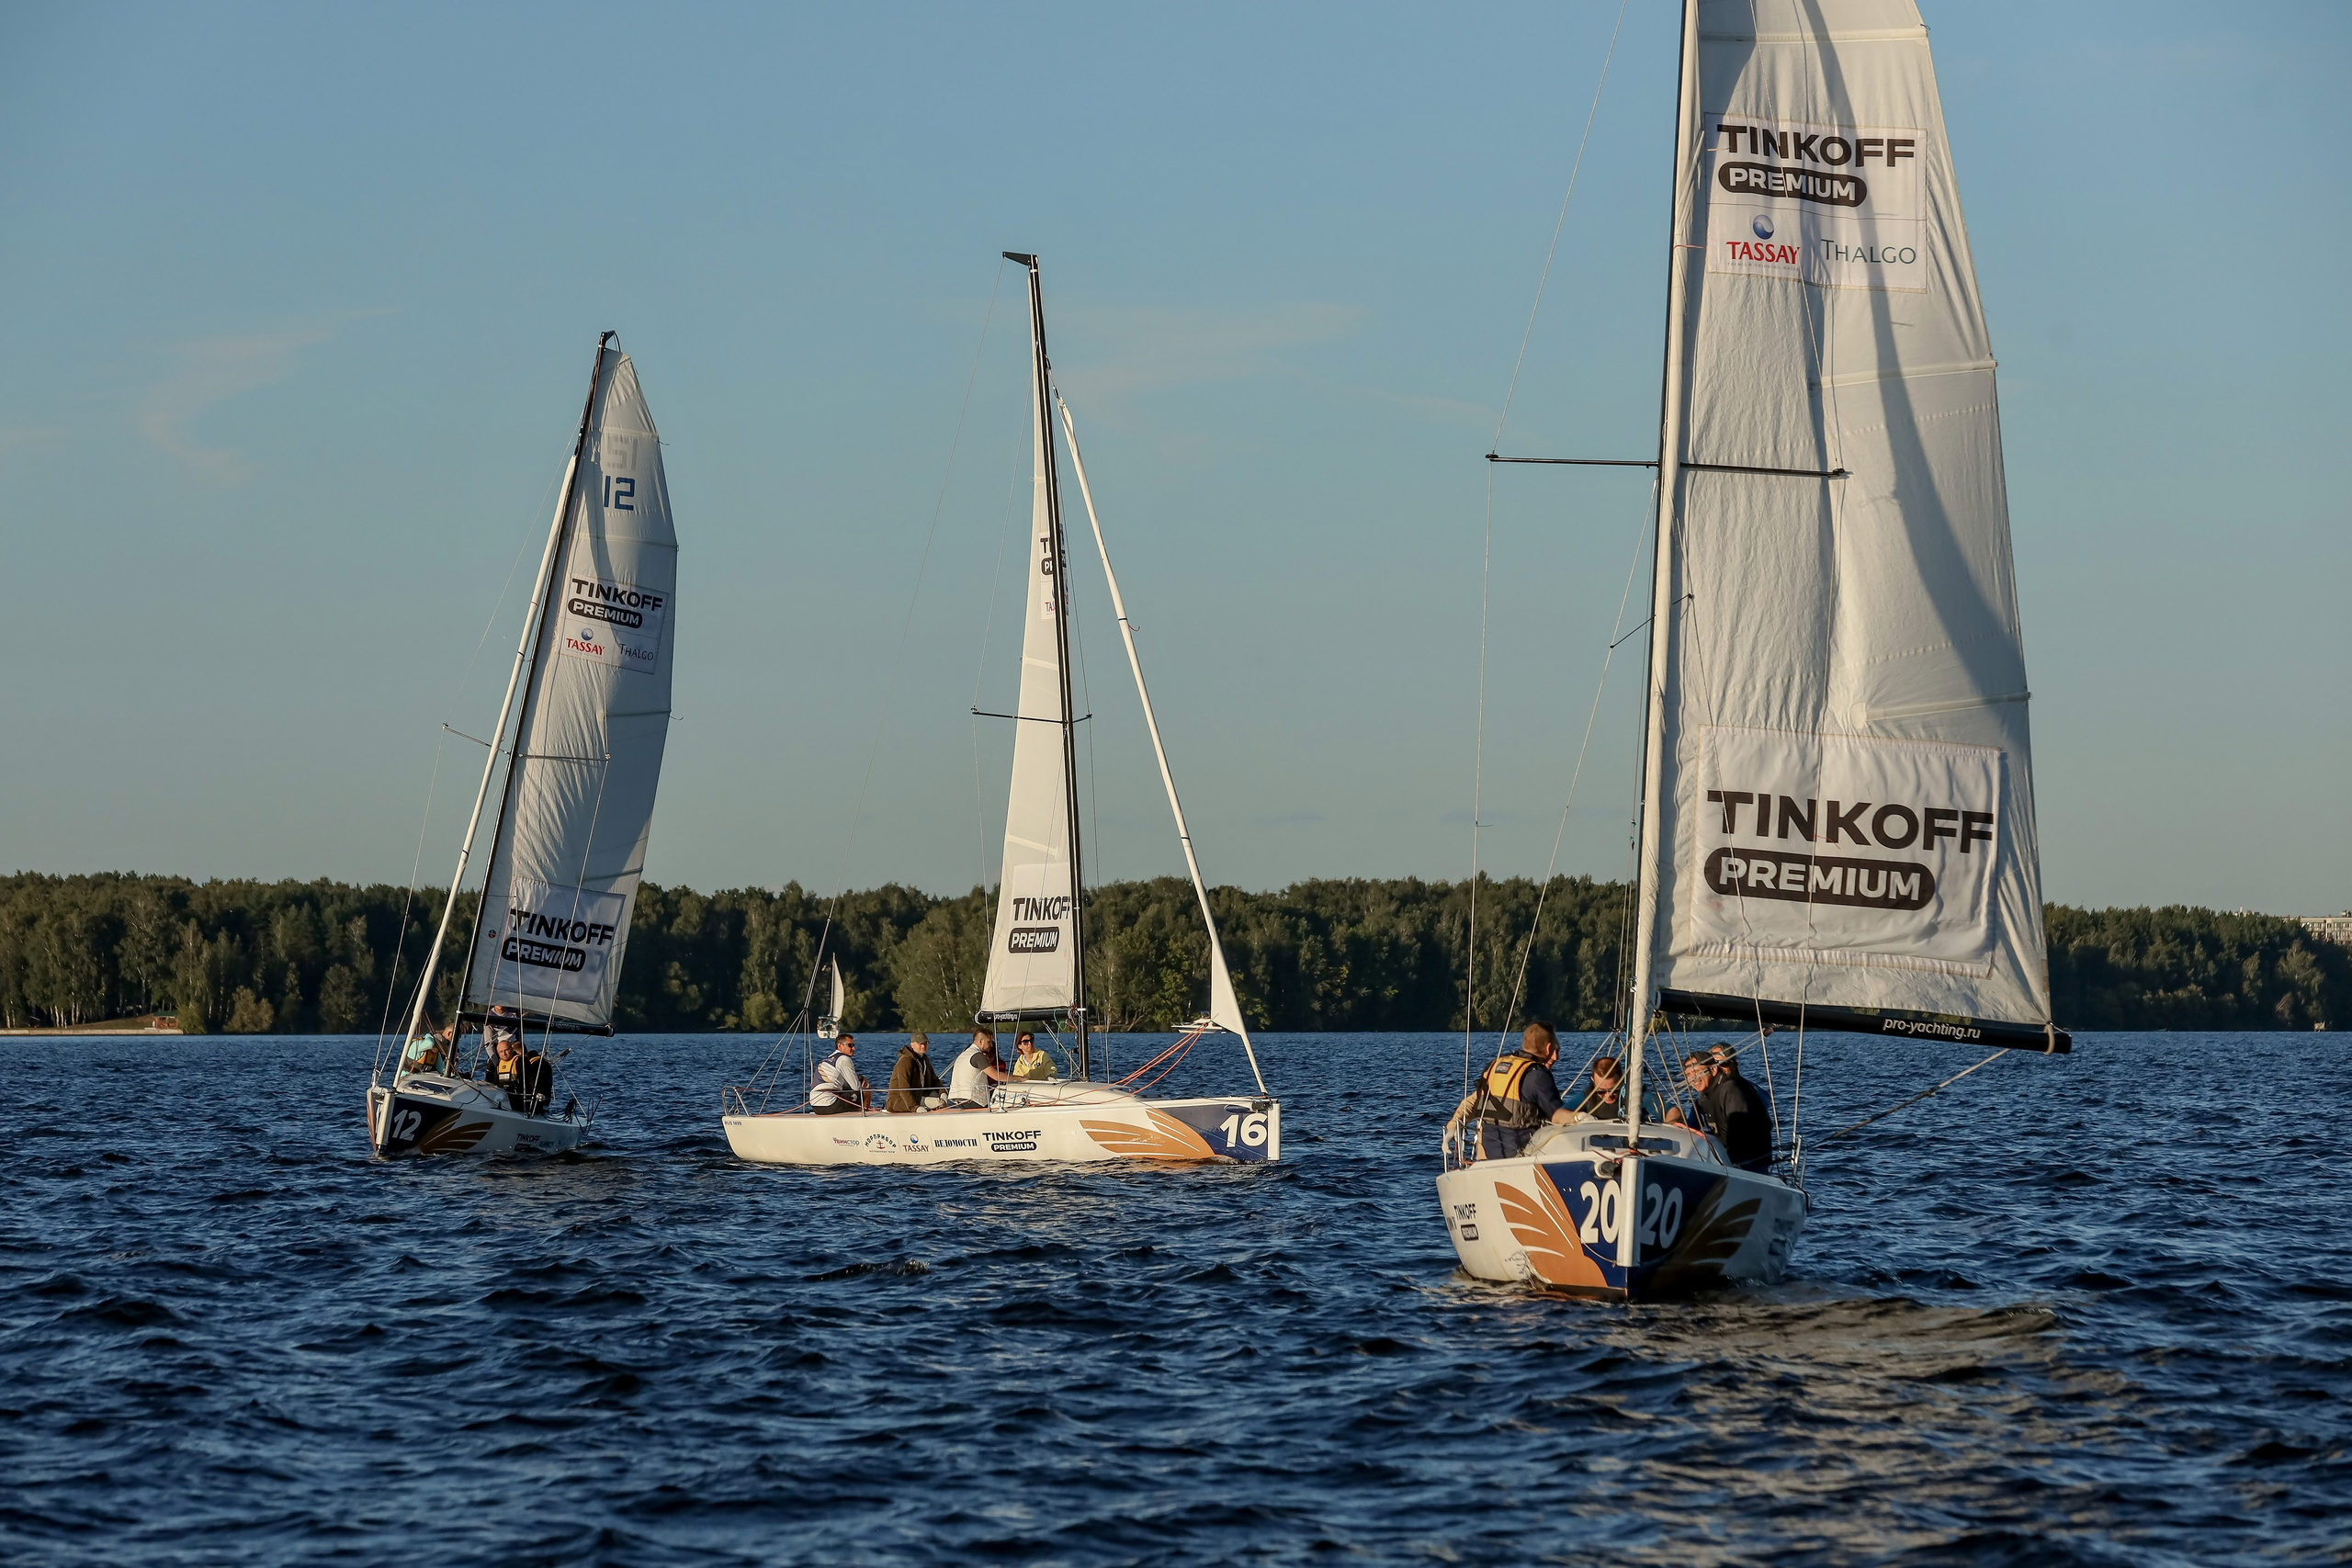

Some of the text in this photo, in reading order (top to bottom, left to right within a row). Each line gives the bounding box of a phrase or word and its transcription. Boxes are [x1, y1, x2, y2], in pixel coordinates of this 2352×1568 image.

[1716, 124, 1915, 167] TINKOFF
[1729, 167, 1856, 201] PREMIUM
[1725, 241, 1801, 265] TASSAY
[1821, 239, 1917, 265] THALGO
[603, 475, 636, 511] 12
[571, 578, 663, 612] TINKOFF
[572, 601, 640, 626] PREMIUM
[566, 637, 605, 656] TASSAY
[619, 643, 654, 661] THALGO
[1707, 790, 1994, 854] TINKOFF
[1718, 856, 1922, 901] PREMIUM
[510, 908, 615, 946] TINKOFF
[1011, 931, 1058, 949] PREMIUM
[506, 941, 582, 968] PREMIUM
[1883, 1018, 1981, 1040] pro-yachting.ru
[392, 1109, 422, 1142] 12
[982, 1130, 1042, 1142] TINKOFF
[1219, 1112, 1268, 1148] 16
[902, 1145, 930, 1153] TASSAY
[993, 1143, 1035, 1151] PREMIUM
[1579, 1179, 1622, 1244] 20
[1640, 1182, 1683, 1249] 20
